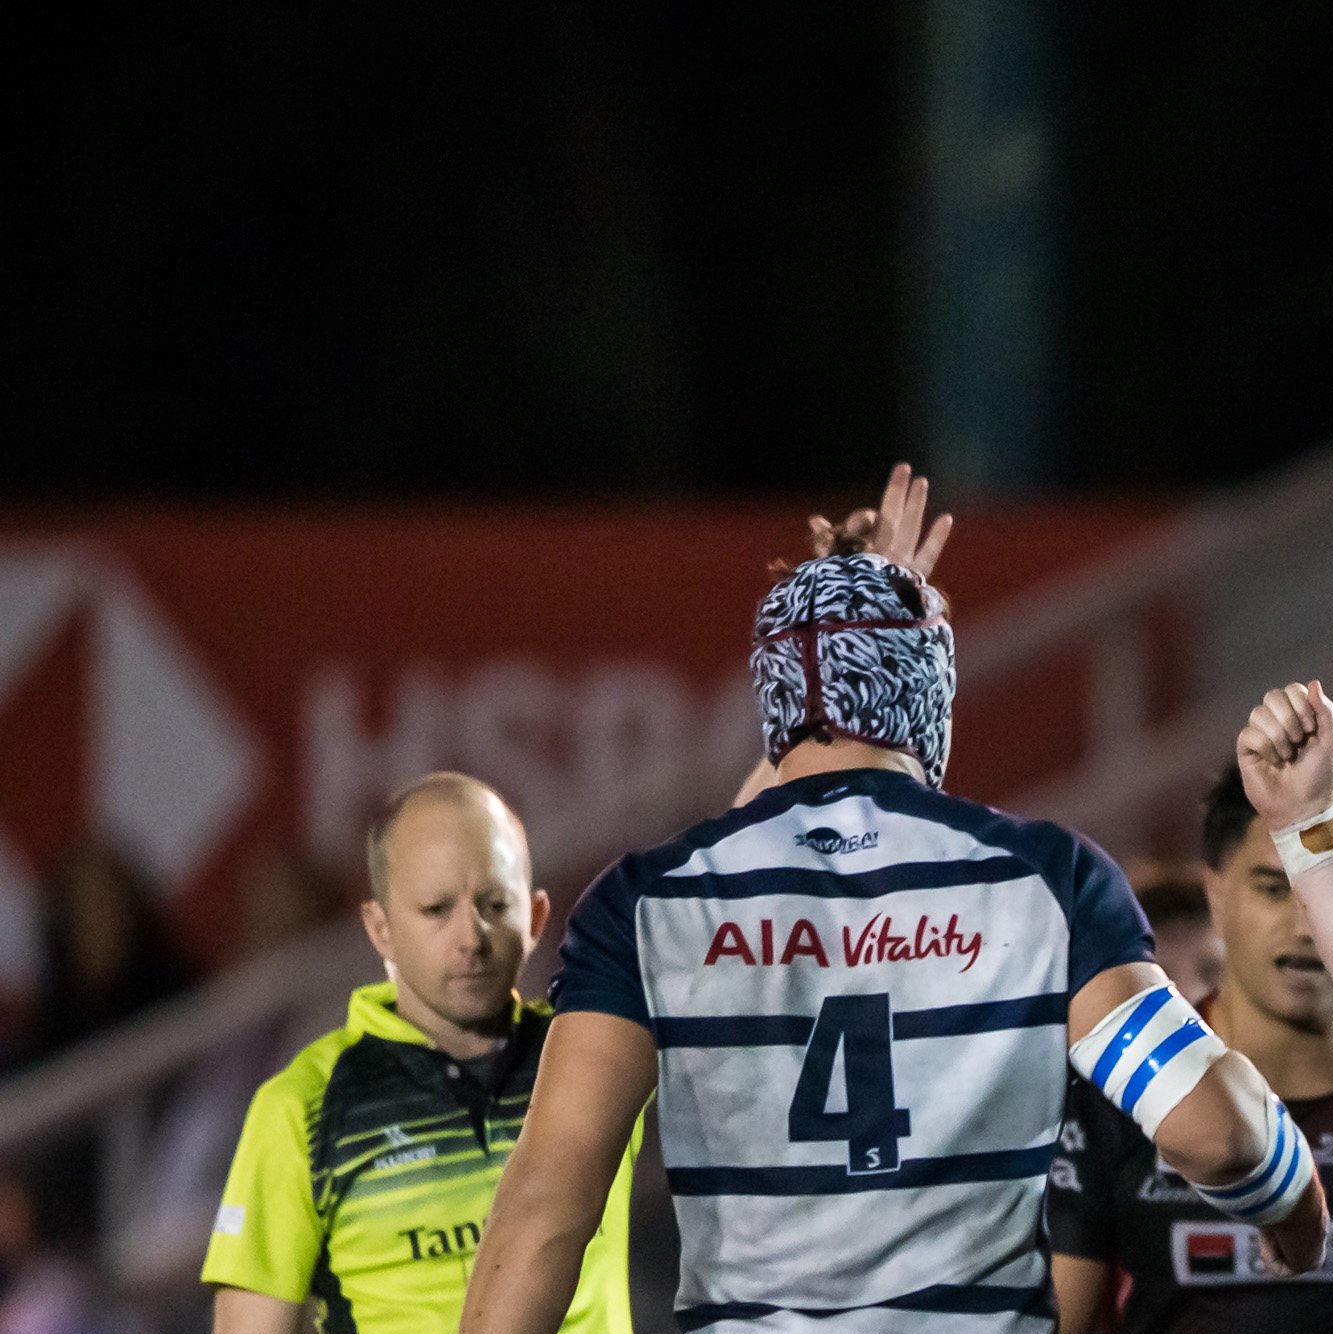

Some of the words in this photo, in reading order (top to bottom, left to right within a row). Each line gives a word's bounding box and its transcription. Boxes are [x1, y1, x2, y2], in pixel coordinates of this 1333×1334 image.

[704, 918, 830, 967] AIA
[842, 911, 983, 974] Vitality
[788, 992, 912, 1173] 4
